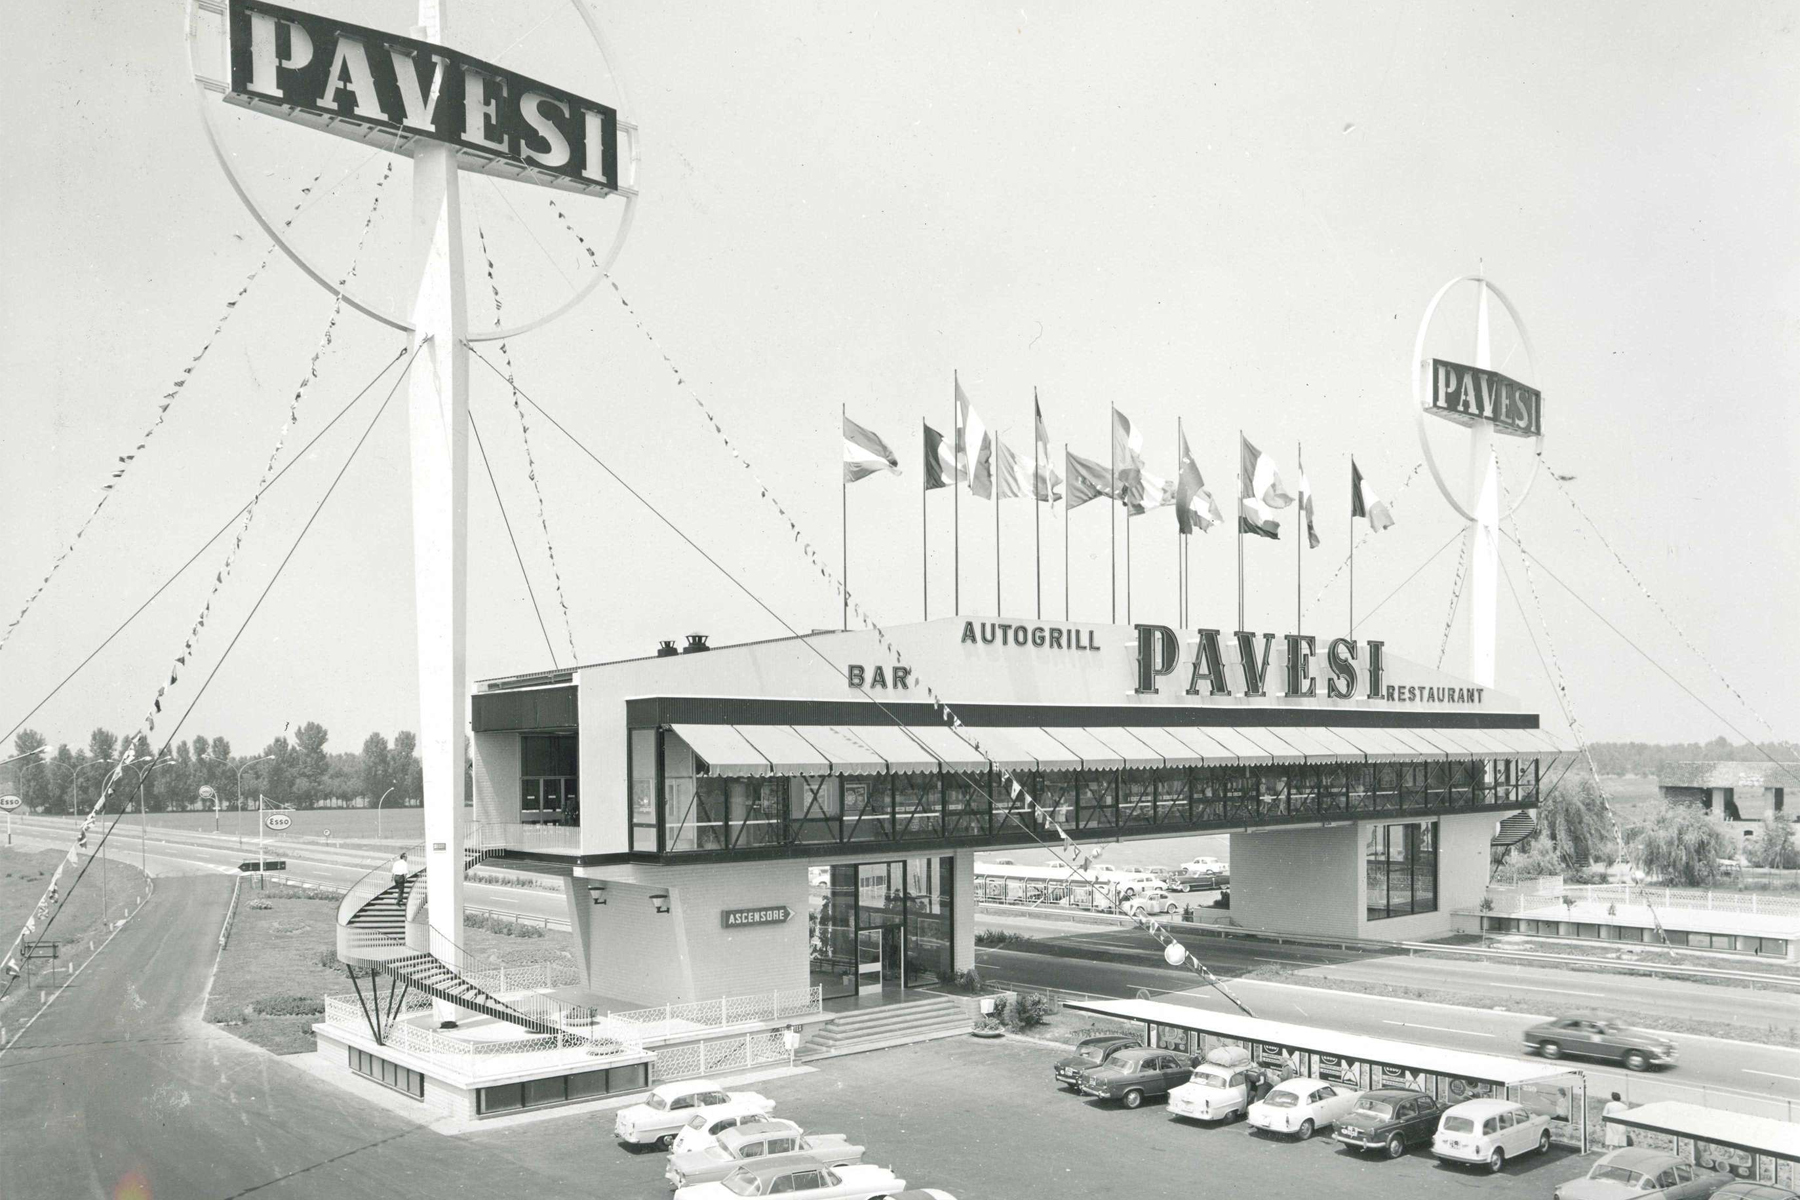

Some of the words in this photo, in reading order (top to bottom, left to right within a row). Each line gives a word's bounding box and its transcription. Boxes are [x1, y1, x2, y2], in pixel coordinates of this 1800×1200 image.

[244, 10, 608, 183] PAVESI
[1437, 363, 1538, 433] PAVESI
[960, 621, 1101, 651] AUTOGRILL
[1134, 623, 1386, 700] PAVESI
[847, 664, 909, 690] BAR
[1386, 685, 1484, 704] RESTAURANT
[728, 909, 785, 925] ASCENSORE
